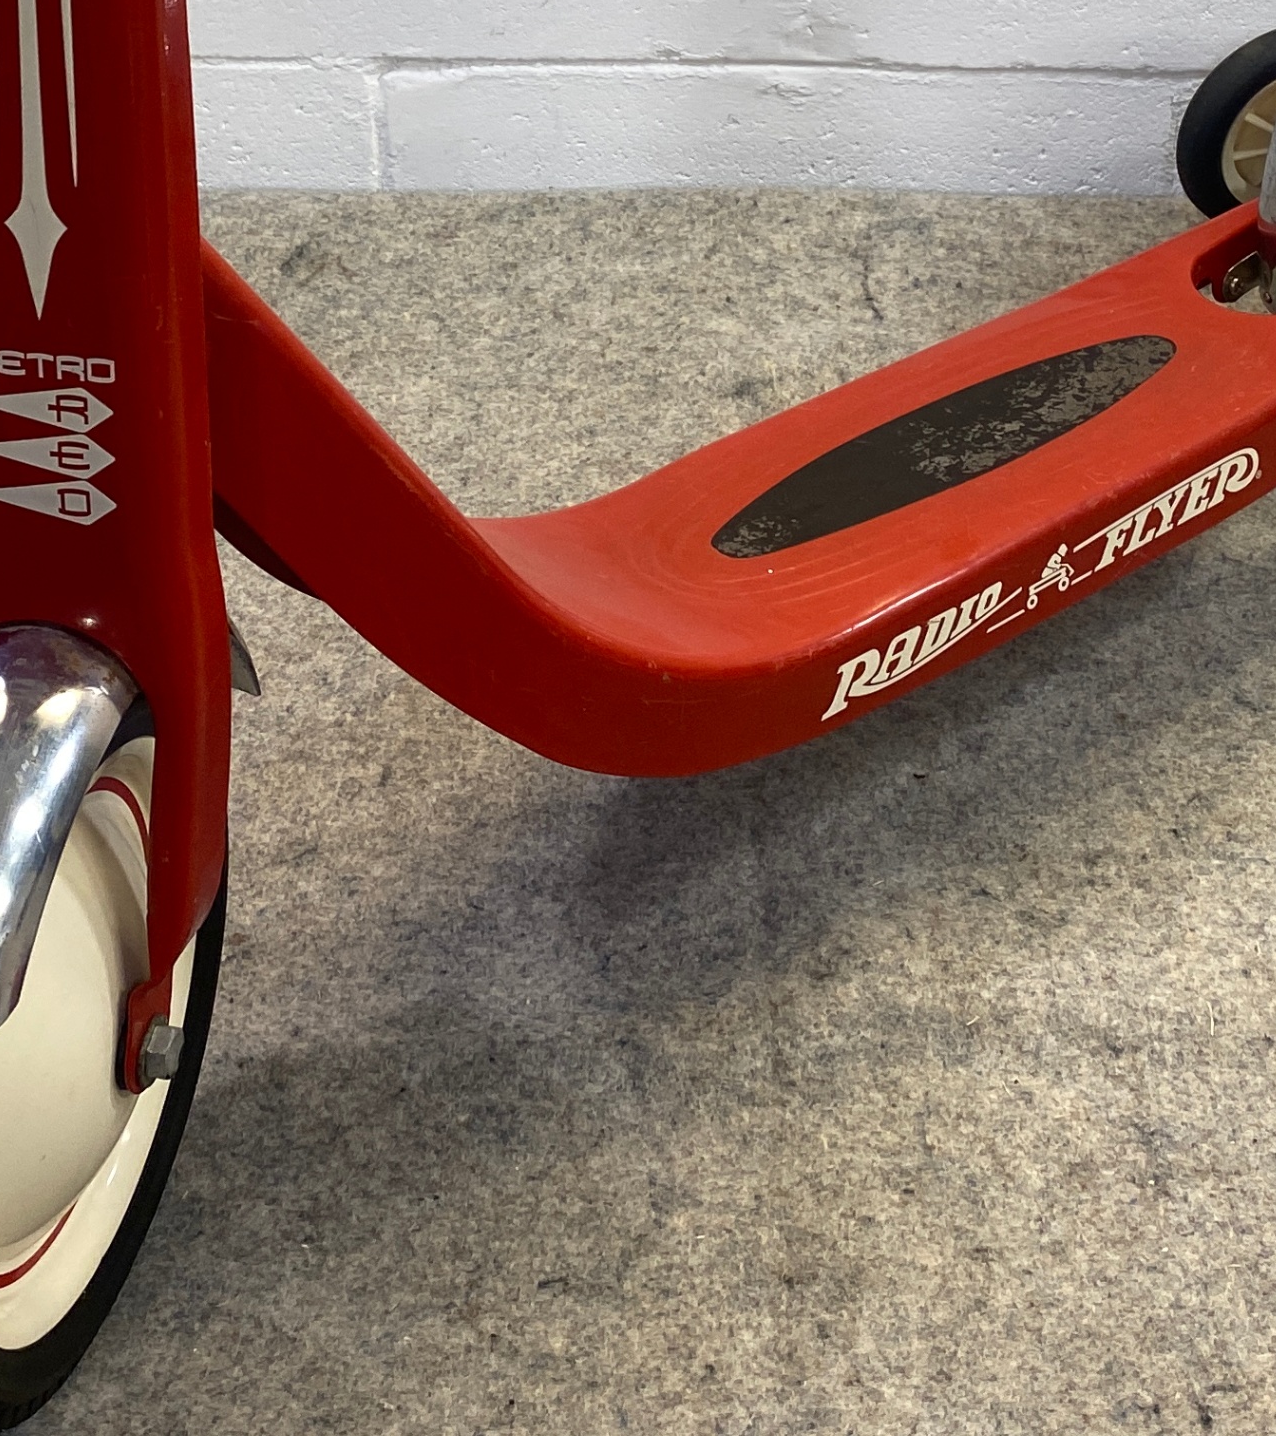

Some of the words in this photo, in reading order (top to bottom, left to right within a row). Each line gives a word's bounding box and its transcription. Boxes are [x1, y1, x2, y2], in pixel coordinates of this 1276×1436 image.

[47, 394, 92, 517] RED
[821, 581, 1004, 721] RADIO
[1093, 447, 1260, 572] FLYER
